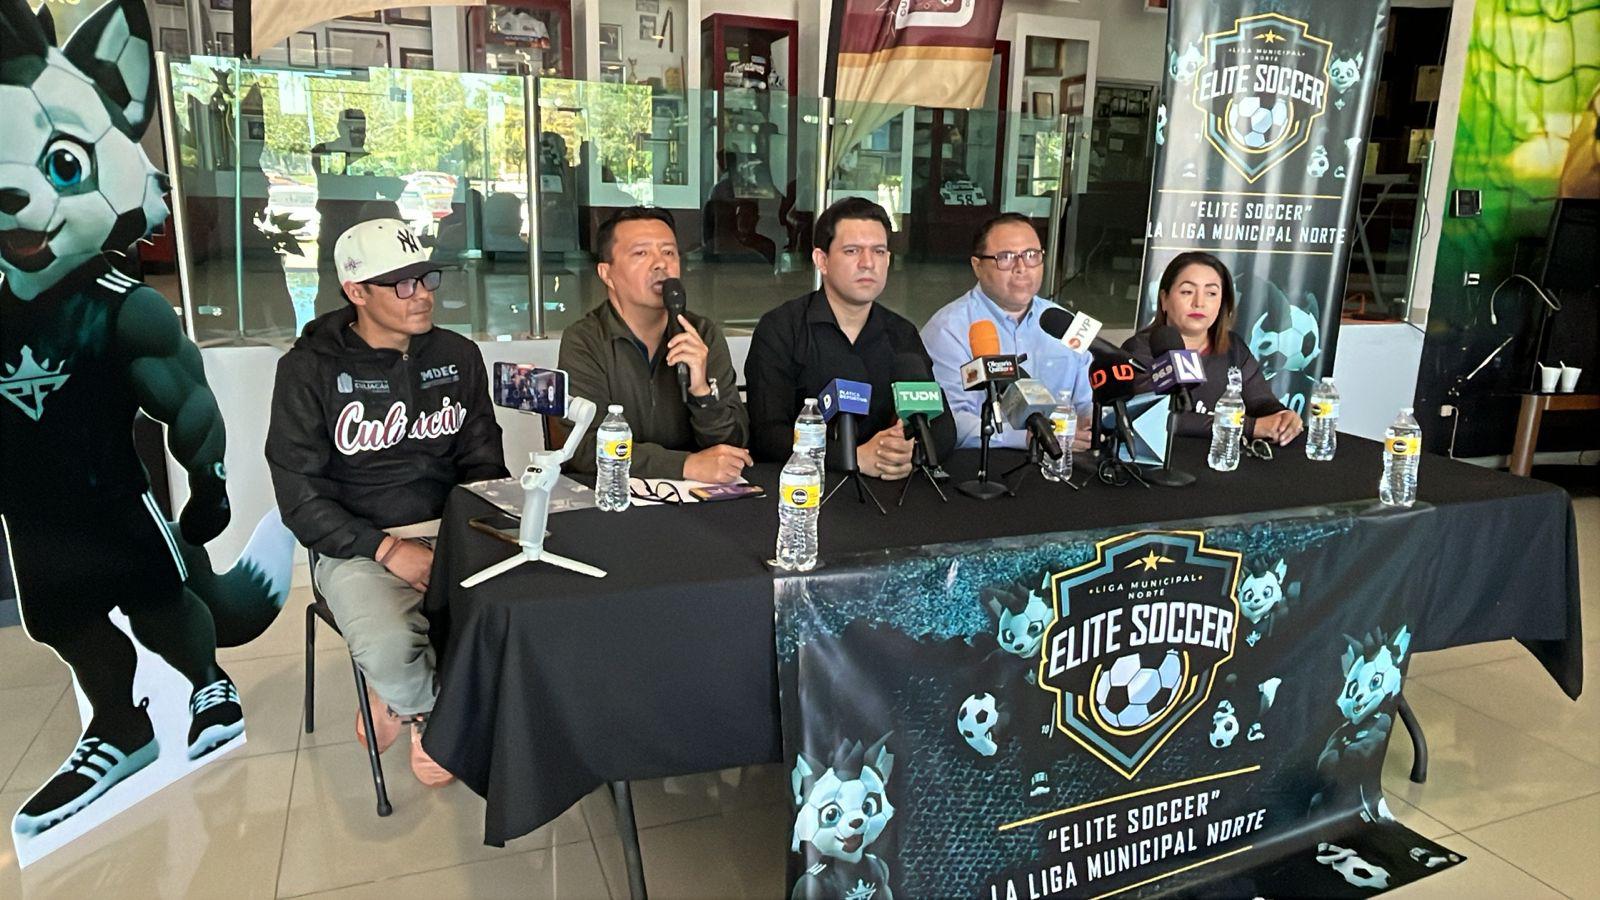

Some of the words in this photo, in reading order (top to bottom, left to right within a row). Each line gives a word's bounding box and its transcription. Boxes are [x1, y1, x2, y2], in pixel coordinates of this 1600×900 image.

[1257, 48, 1302, 56] MUNICIPAL
[1200, 64, 1251, 102] ELITE
[1253, 63, 1325, 109] SOCCER
[1147, 222, 1163, 238] LA
[1171, 223, 1205, 239] LIGA
[1212, 224, 1292, 242] MUNICIPAL
[1299, 227, 1346, 244] NORTE
[421, 364, 458, 381] MDEC
[899, 390, 940, 401] TUDN
[1095, 583, 1124, 594] LIGA
[1130, 575, 1197, 590] MUNICIPAL
[1128, 588, 1165, 600] NORTE
[1048, 607, 1123, 678] ELITE
[1129, 601, 1234, 652] SOCCER
[991, 878, 1017, 900] LA
[1028, 861, 1077, 900] LIGA
[1087, 828, 1197, 882] MUNICIPAL
[1206, 808, 1267, 846] NORTE
